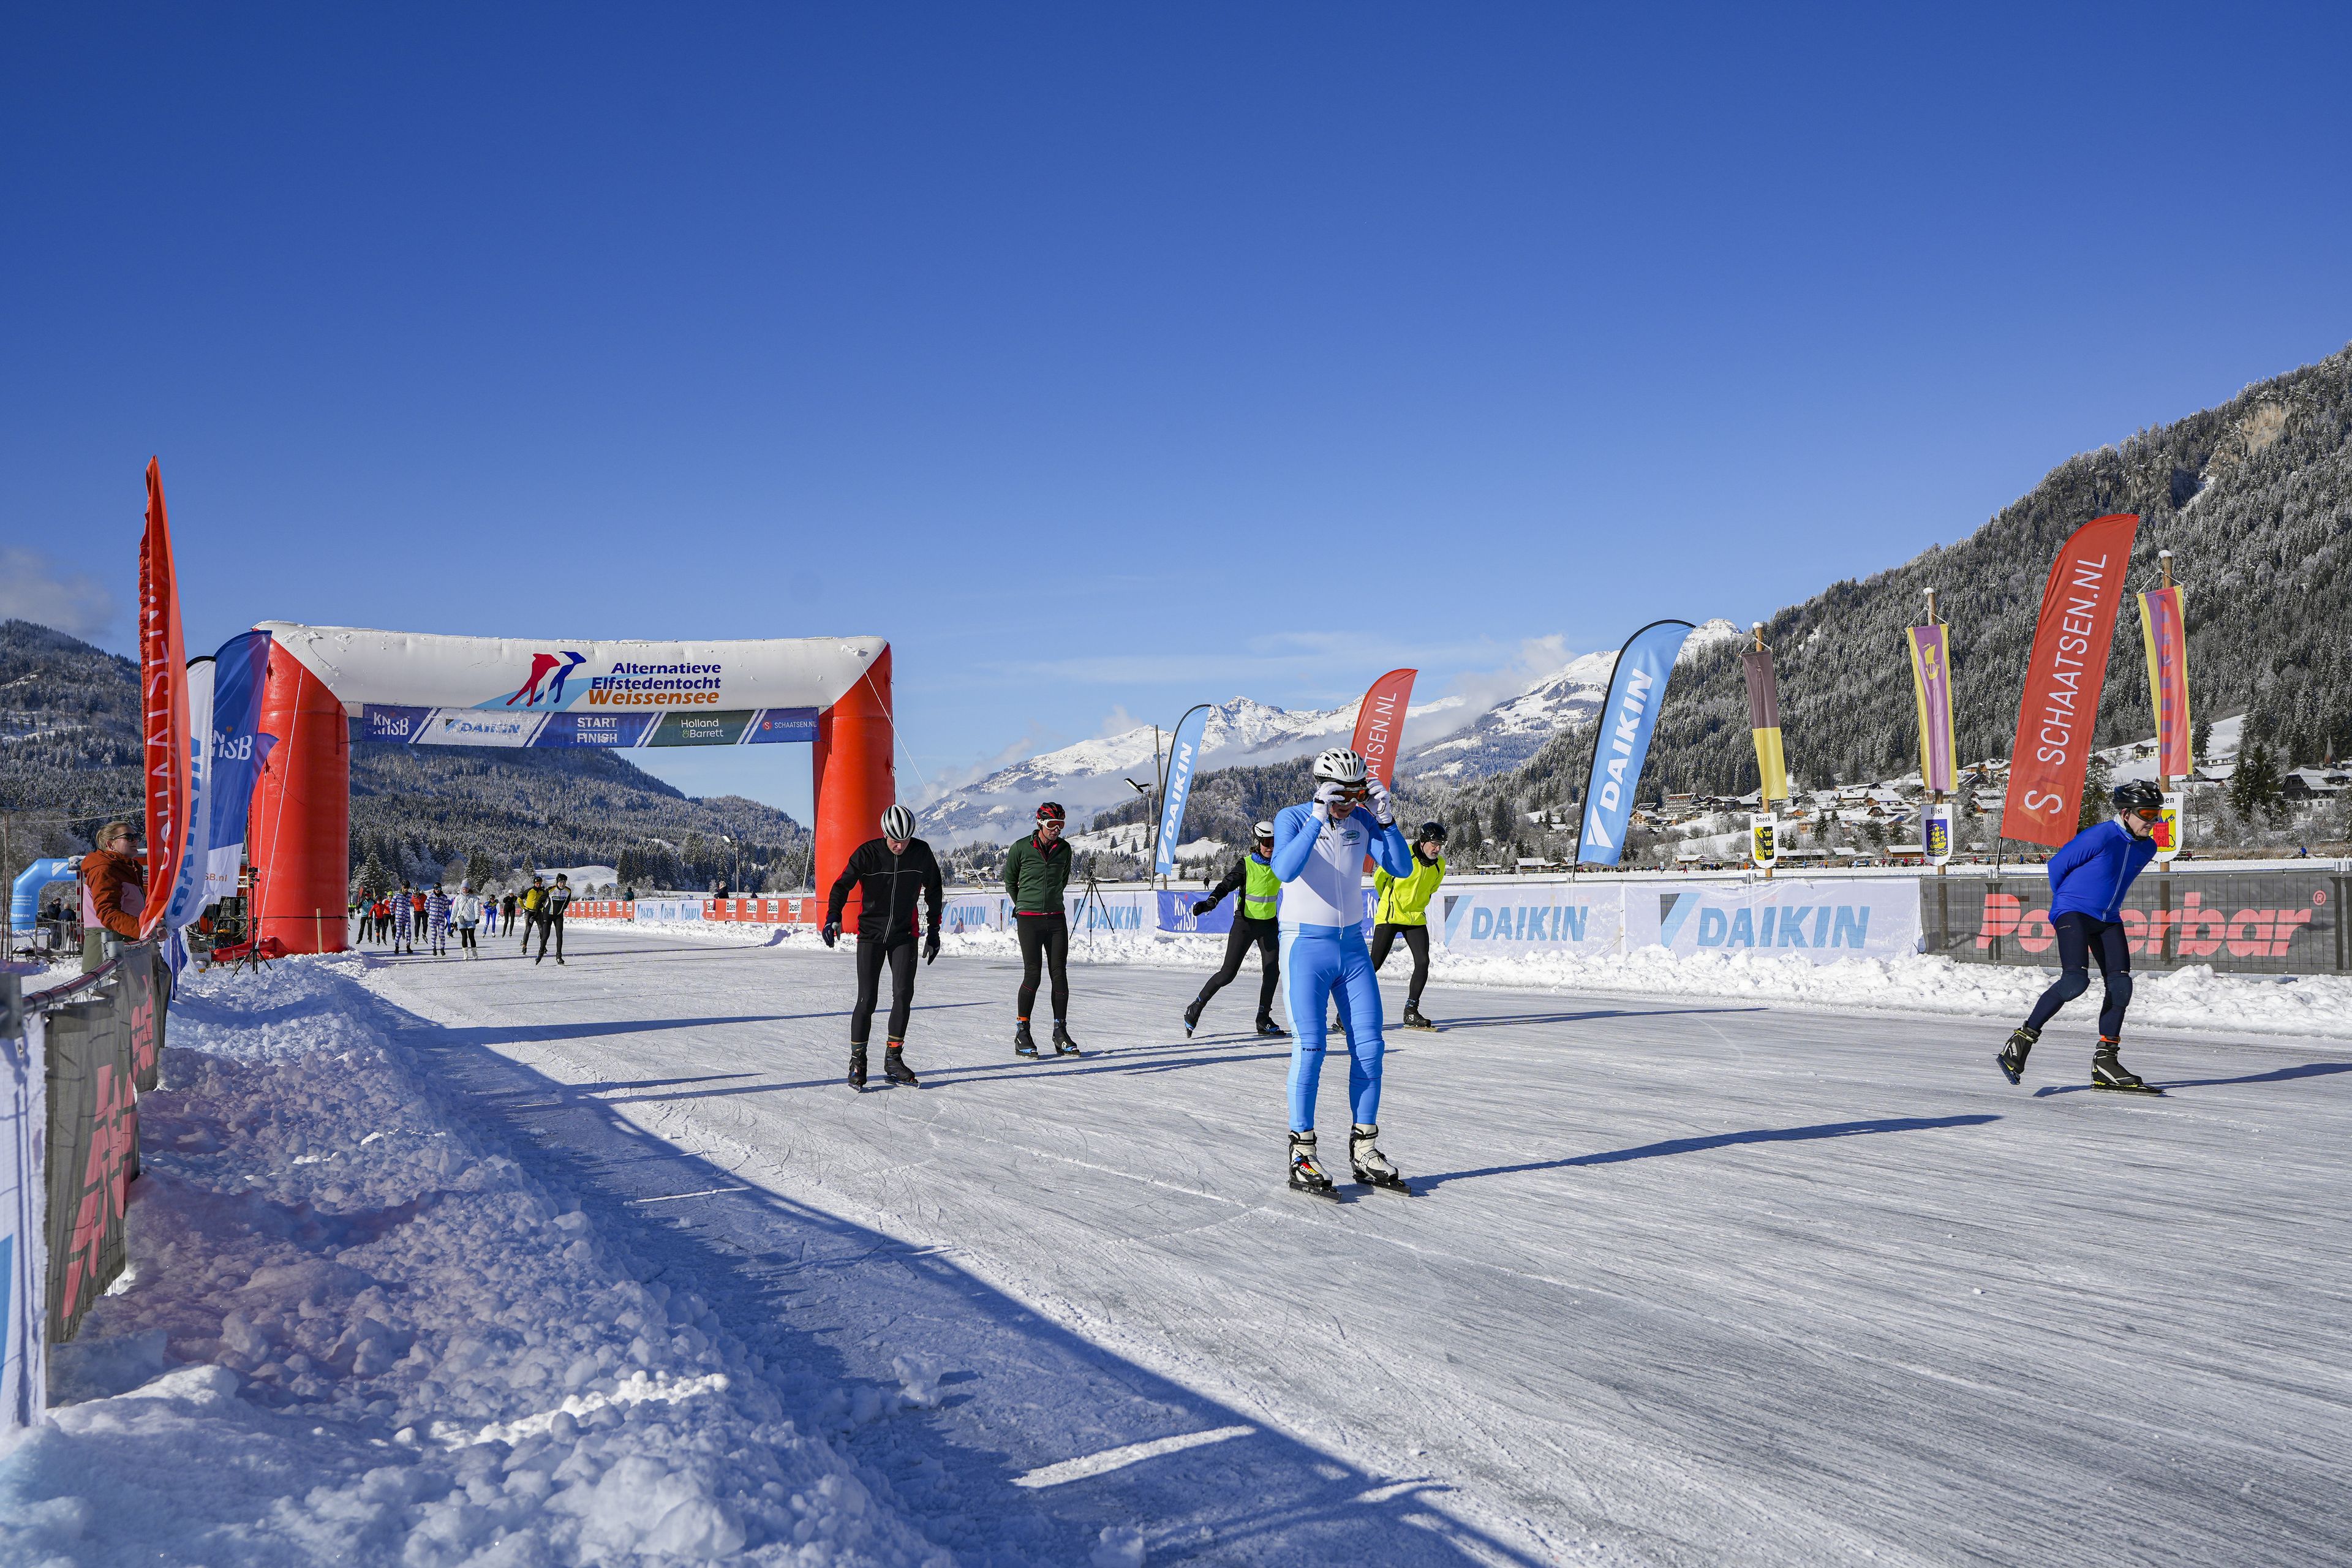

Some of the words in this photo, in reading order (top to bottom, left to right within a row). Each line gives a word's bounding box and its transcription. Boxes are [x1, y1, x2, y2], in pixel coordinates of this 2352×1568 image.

[611, 662, 722, 674] Alternatieve
[2037, 554, 2107, 766] SCHAATSEN.NL
[591, 676, 722, 690] Elfstedentocht
[588, 689, 720, 706] Weissensee
[373, 711, 409, 736] KNSB
[577, 717, 617, 728] START
[680, 718, 719, 728] Holland
[211, 729, 252, 760] NSB
[577, 733, 617, 743] FINISH
[1364, 692, 1397, 781] ATSEN.NL
[1599, 668, 1653, 813] DAIKIN
[1164, 741, 1193, 840] DAIKIN
[747, 902, 756, 911] Boels
[768, 902, 778, 912] Boels
[950, 905, 986, 926] DAIKIN
[1088, 905, 1143, 930] DAIKIN
[1471, 906, 1588, 941] DAIKIN
[1696, 906, 1871, 949] DAIKIN
[1975, 891, 2312, 957] Poerbar
